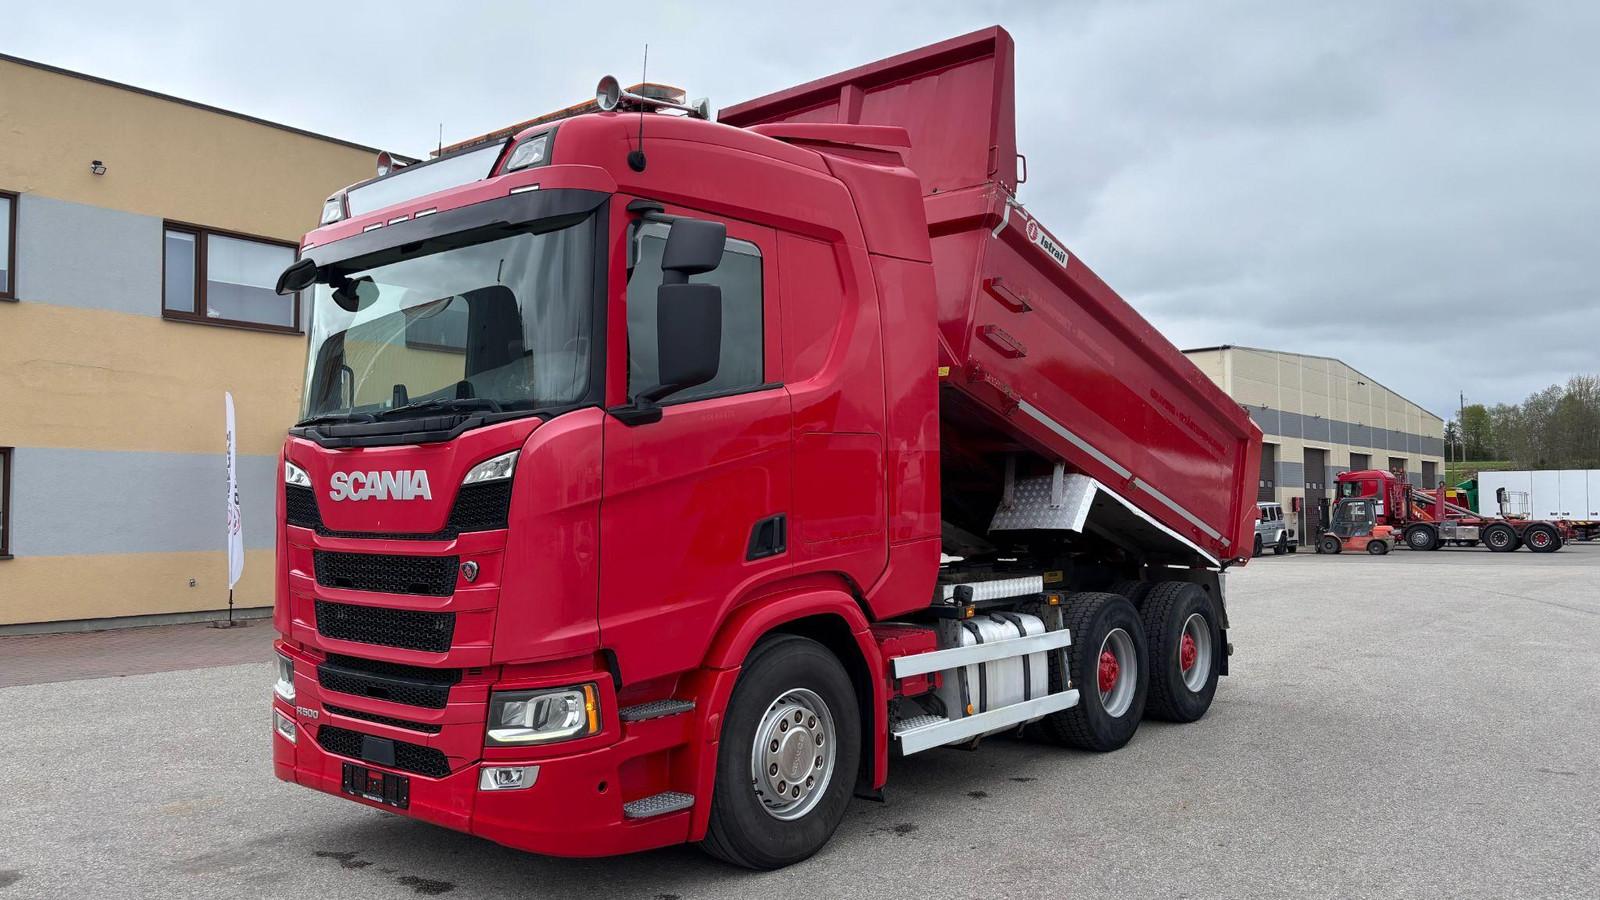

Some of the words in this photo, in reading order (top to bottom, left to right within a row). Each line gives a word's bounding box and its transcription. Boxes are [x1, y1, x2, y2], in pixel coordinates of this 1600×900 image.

[1040, 235, 1066, 263] Istrail
[329, 470, 432, 501] SCANIA
[296, 706, 319, 719] R500
